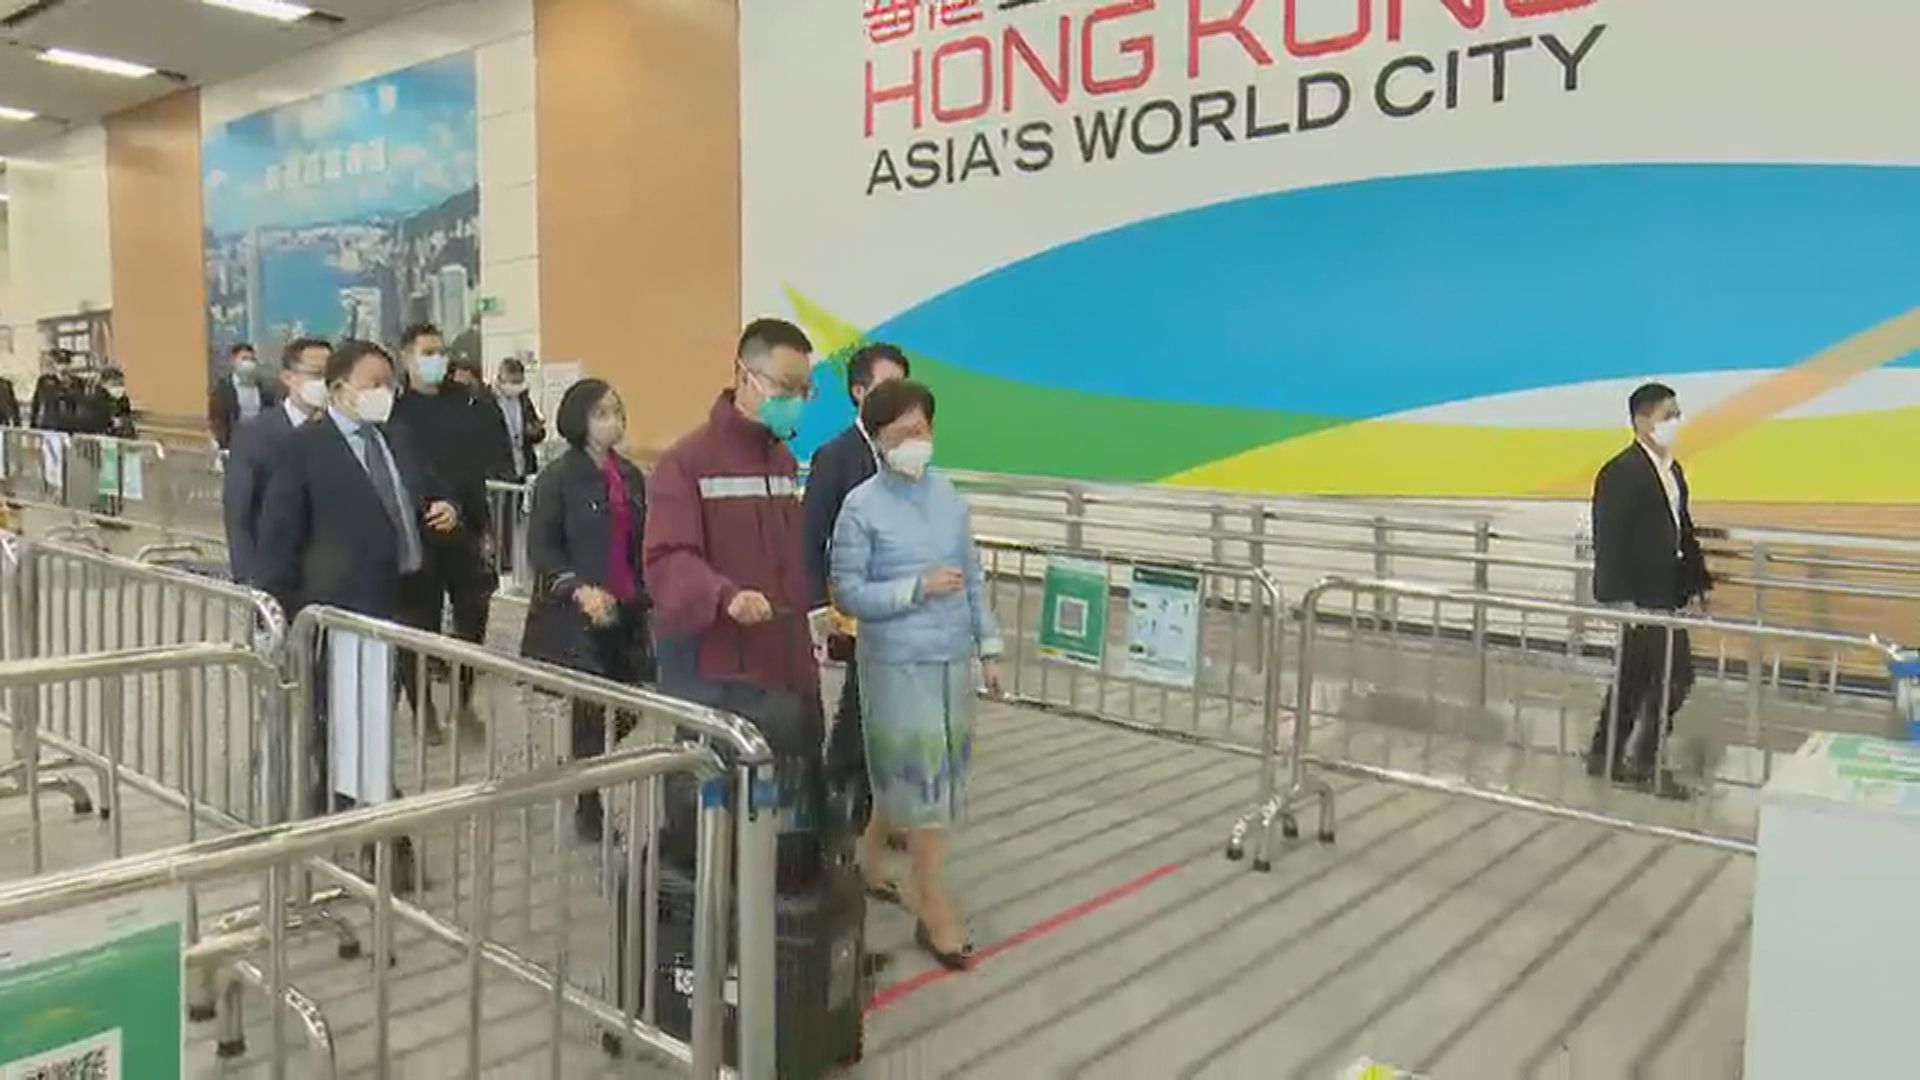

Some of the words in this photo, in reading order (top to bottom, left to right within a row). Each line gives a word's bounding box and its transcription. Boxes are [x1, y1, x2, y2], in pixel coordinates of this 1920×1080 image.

[863, 0, 1156, 137] HONG
[865, 121, 1054, 195] ASIA'S
[1074, 71, 1351, 163] WORLD
[1374, 24, 1606, 118] CITY
